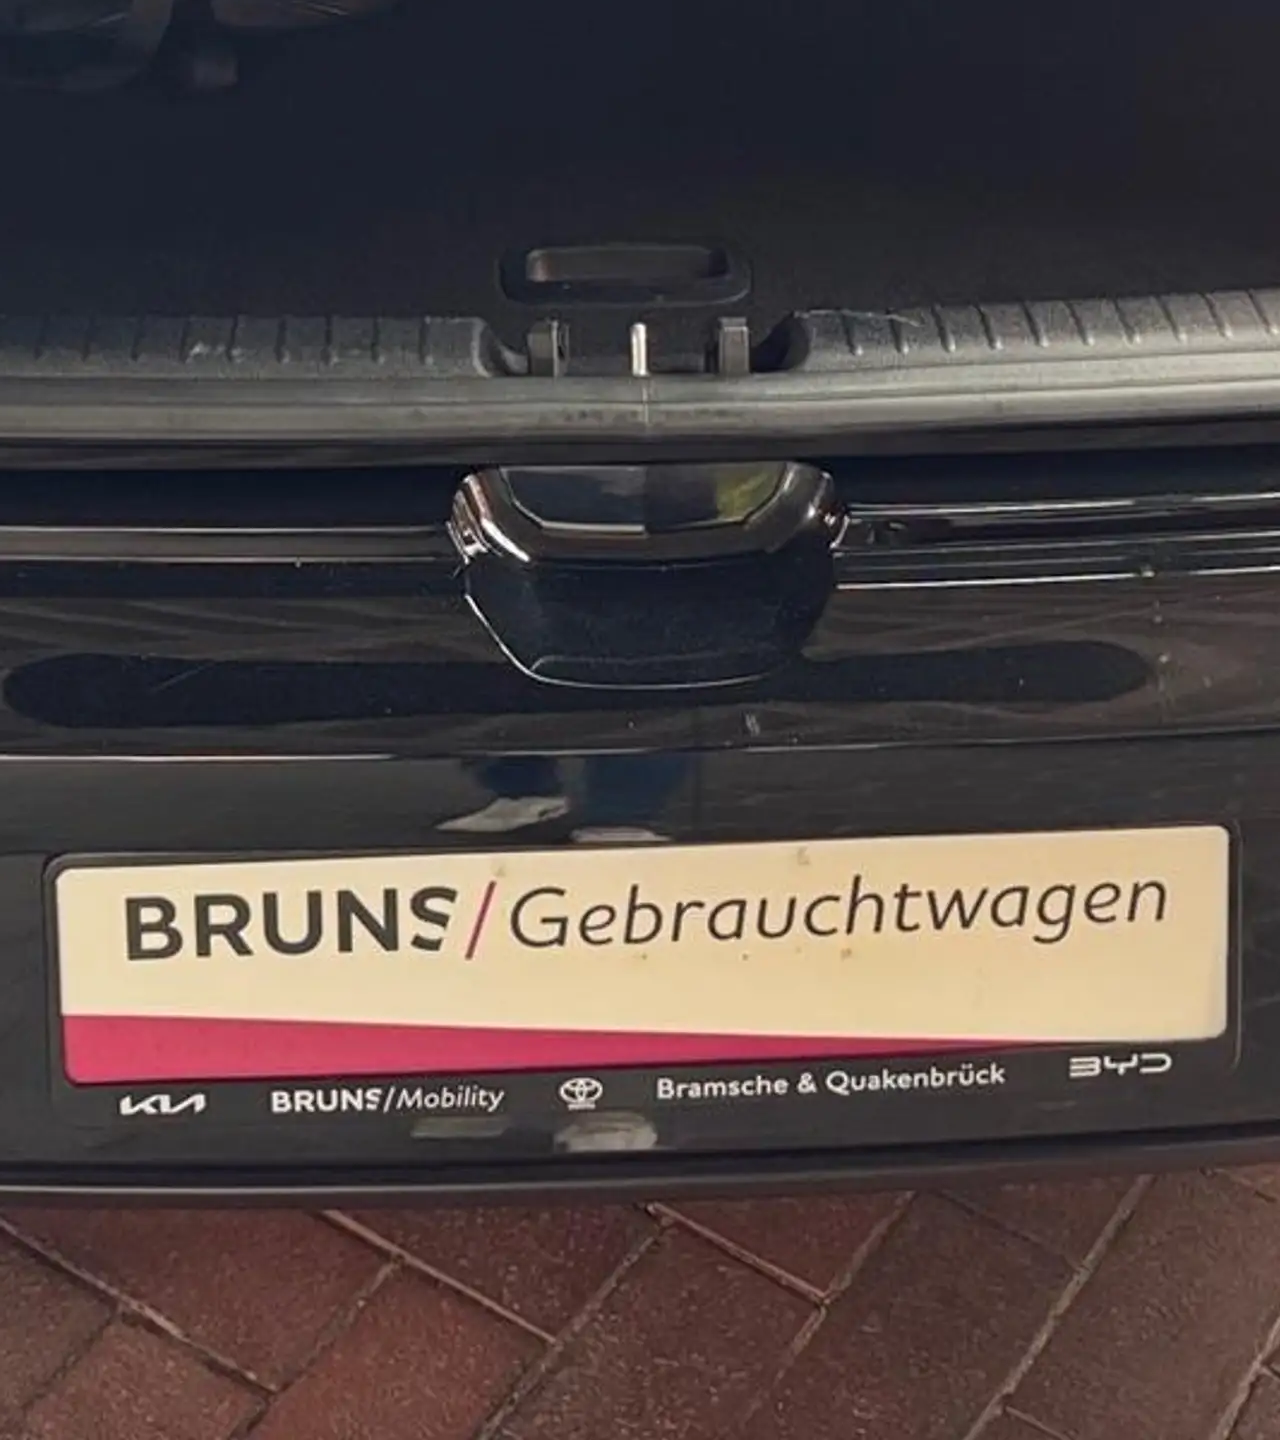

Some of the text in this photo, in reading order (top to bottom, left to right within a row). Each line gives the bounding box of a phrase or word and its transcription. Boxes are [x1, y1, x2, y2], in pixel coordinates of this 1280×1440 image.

[656, 1062, 1006, 1100] Bramsche & Quakenbrück
